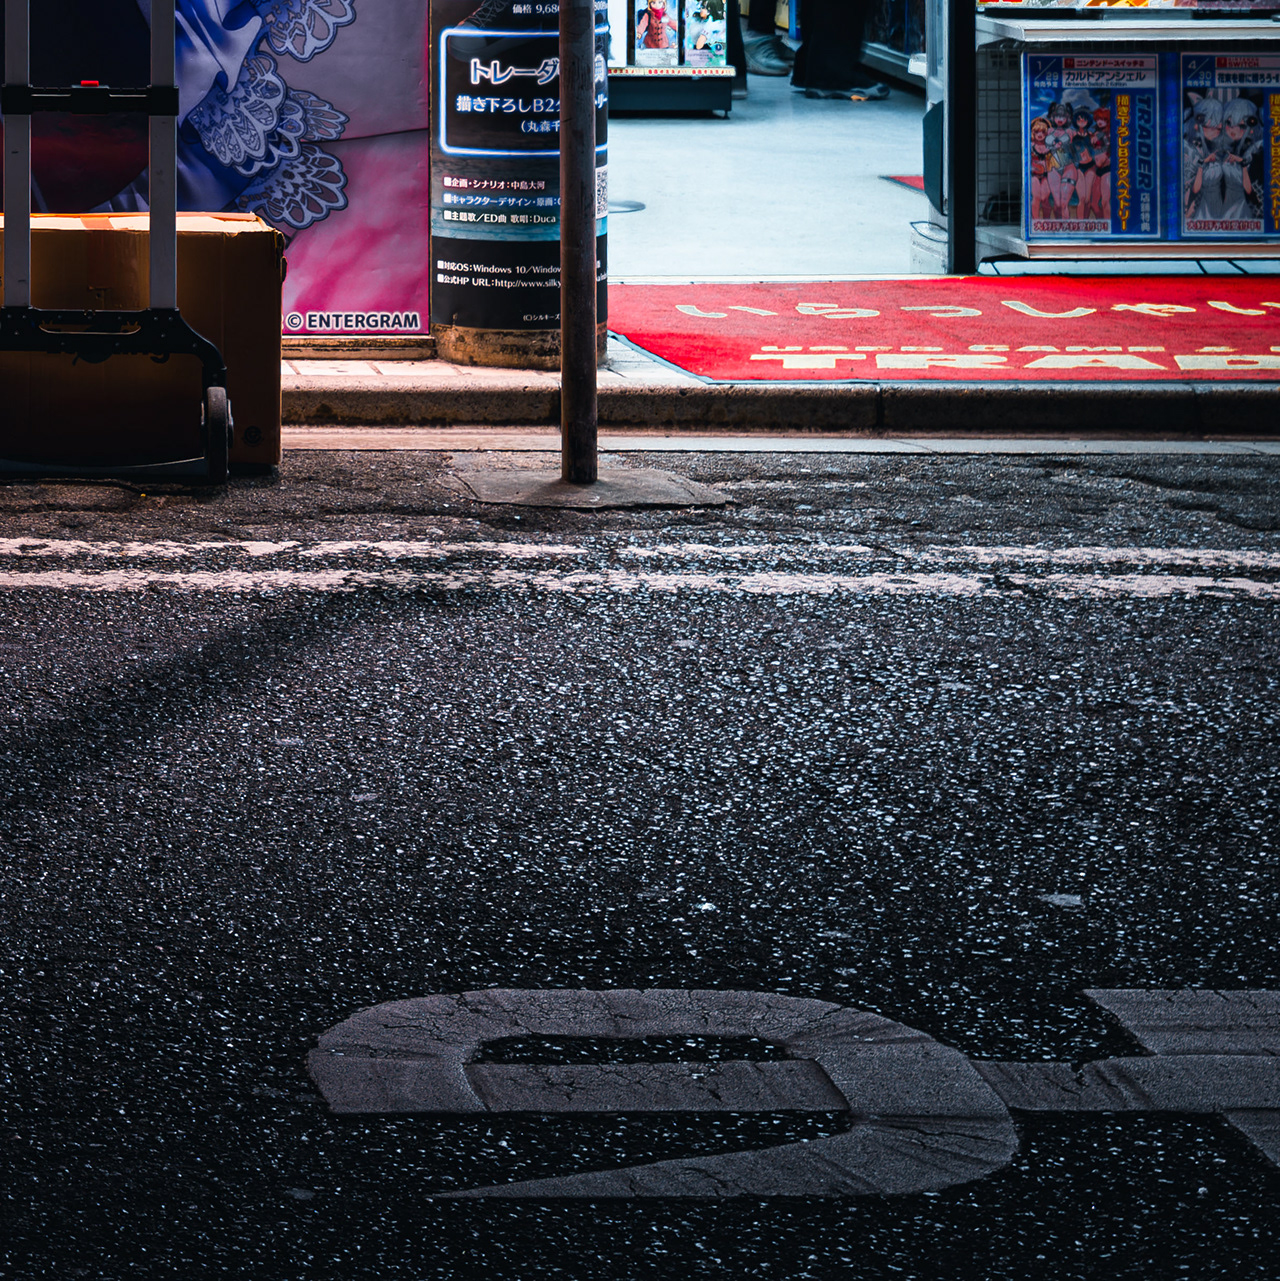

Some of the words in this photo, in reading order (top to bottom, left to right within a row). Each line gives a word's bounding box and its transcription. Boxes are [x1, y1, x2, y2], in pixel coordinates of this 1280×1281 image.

[512, 4, 532, 14] 価格
[1136, 95, 1154, 190] TRADER
[305, 313, 419, 329] ENTERGRAM
